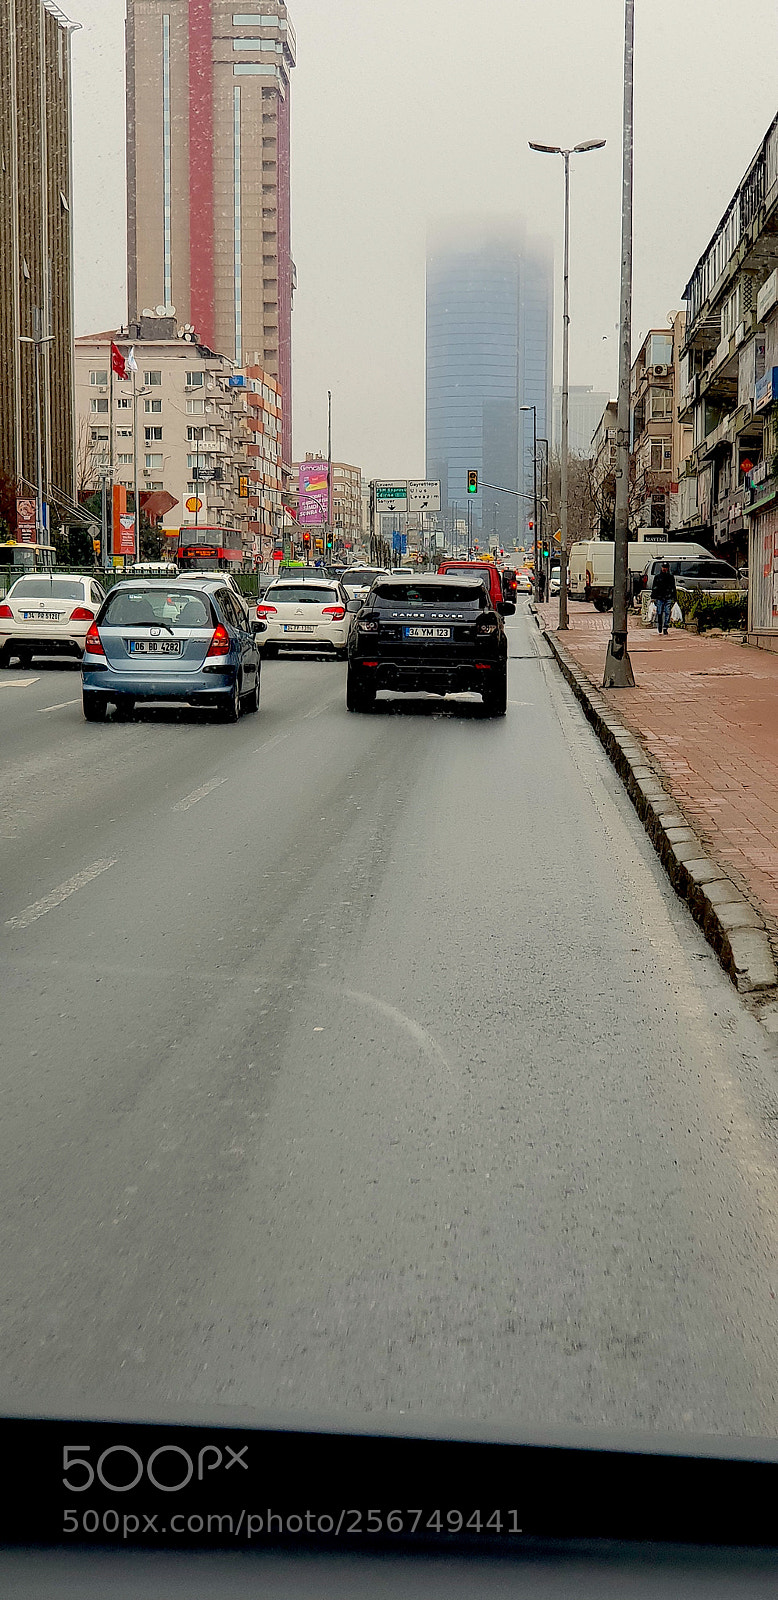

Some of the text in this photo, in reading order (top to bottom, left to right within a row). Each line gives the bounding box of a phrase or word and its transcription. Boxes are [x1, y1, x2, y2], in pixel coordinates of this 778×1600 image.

[409, 629, 450, 638] 34 YM 123
[135, 642, 145, 651] 06
[161, 643, 179, 652] 4282
